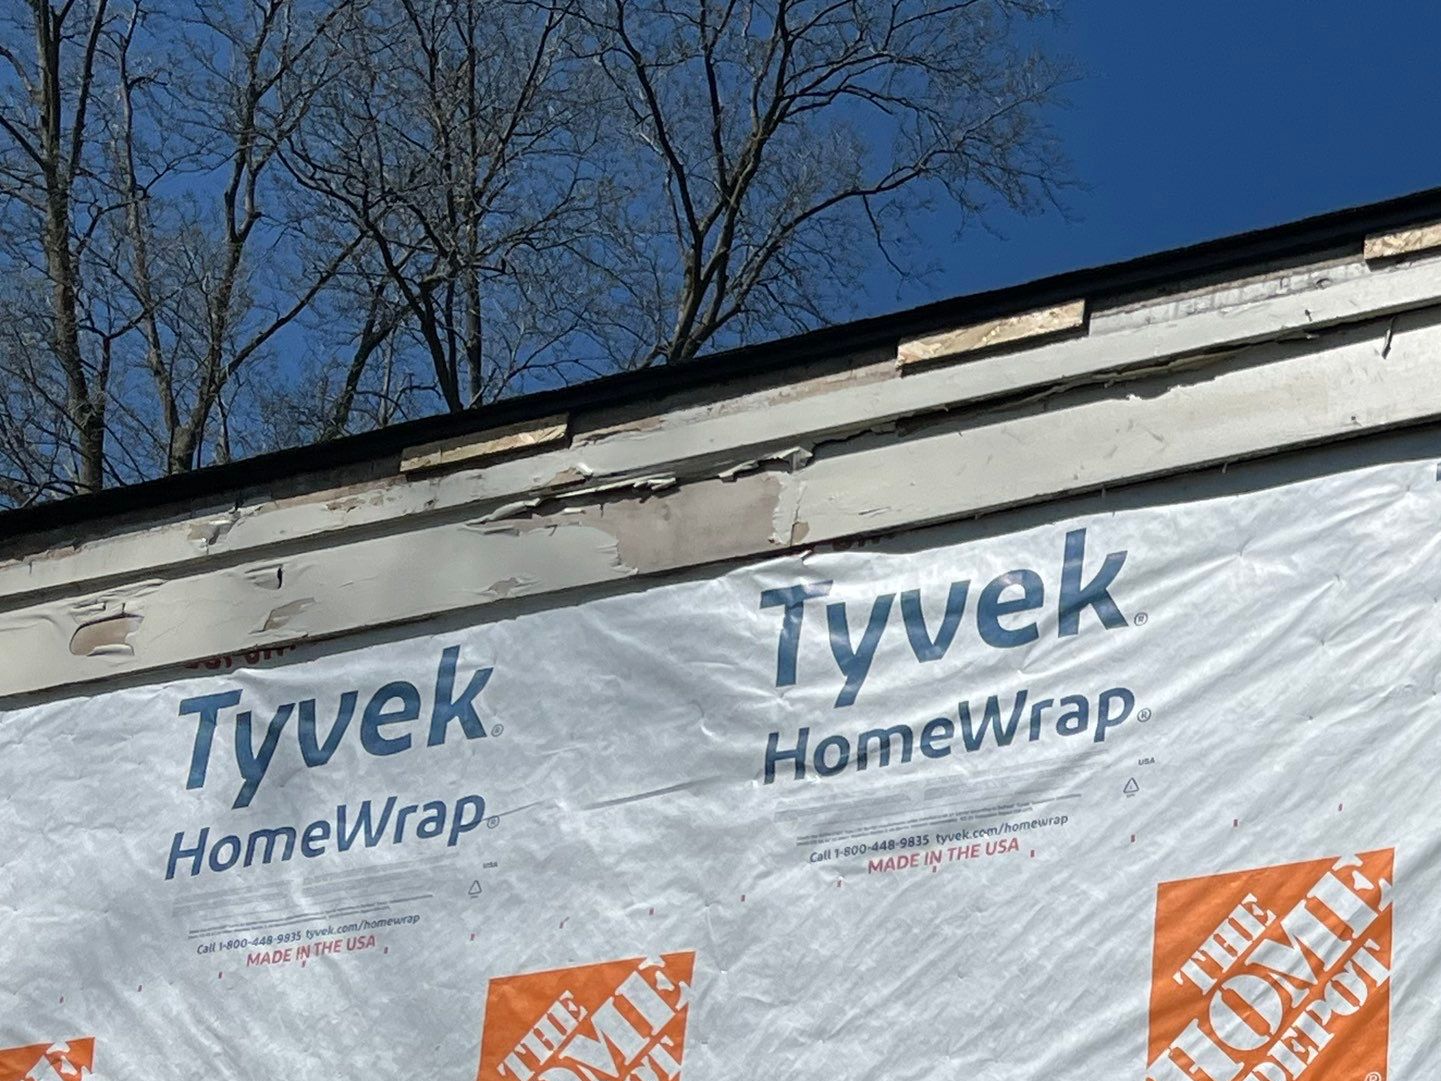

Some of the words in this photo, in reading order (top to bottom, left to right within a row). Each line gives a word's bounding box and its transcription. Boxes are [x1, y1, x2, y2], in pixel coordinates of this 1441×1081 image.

[760, 528, 1128, 708] Tyvek
[178, 645, 495, 810] Tyvek
[763, 686, 1137, 784] HomeWrap
[165, 793, 486, 880] HomeWrap
[810, 850, 832, 864] Call
[834, 833, 930, 859] 1-800-448-9835
[935, 813, 1069, 845] tyvek.com/homewrap
[867, 854, 919, 874] MADE
[924, 850, 942, 866] IN
[947, 844, 980, 861] THE
[985, 837, 1020, 854] USA
[197, 941, 216, 955] Call
[218, 931, 301, 951] 1-800-448-9835
[305, 913, 420, 942] tyvek.com/homewrap
[245, 948, 292, 968] MADE
[296, 946, 310, 960] IN
[314, 940, 341, 957] THE
[346, 934, 376, 951] USA
[1173, 894, 1278, 995] THE
